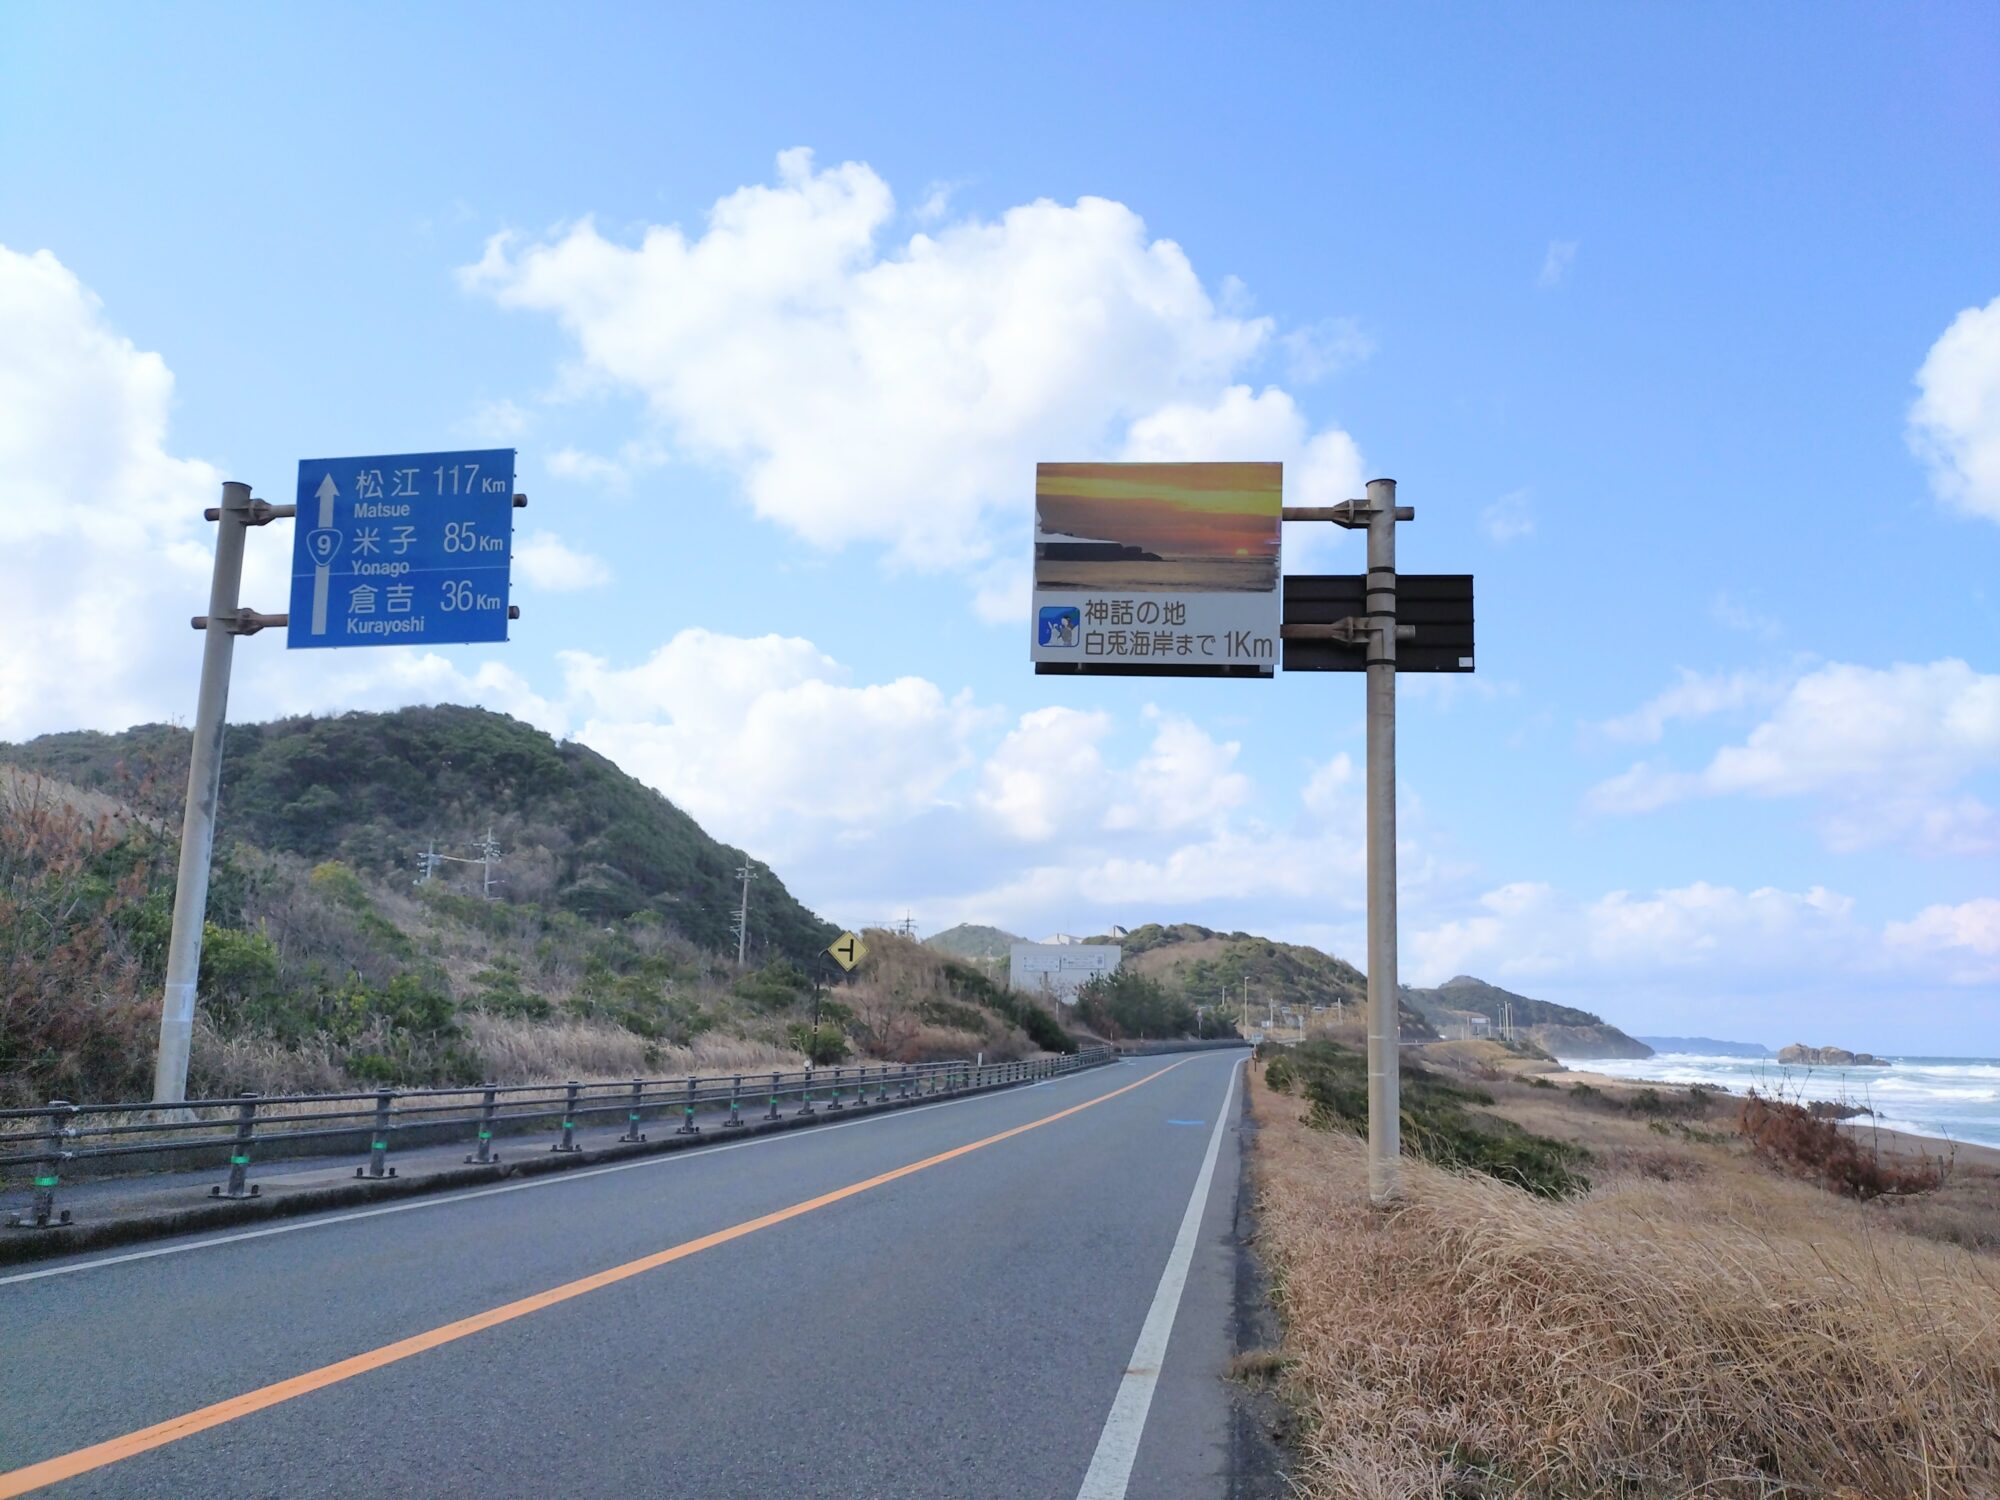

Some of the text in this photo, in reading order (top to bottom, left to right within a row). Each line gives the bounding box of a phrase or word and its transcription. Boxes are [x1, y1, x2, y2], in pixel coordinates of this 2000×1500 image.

[355, 468, 420, 499] 松江
[354, 503, 410, 519] Matsue
[317, 535, 332, 556] 9
[352, 525, 417, 556] 米子
[351, 560, 410, 578] Yonago
[348, 583, 414, 614] 倉吉
[346, 616, 425, 636] Kurayoshi
[1084, 599, 1186, 627] 神話の地
[1223, 631, 1273, 658] 1Km
